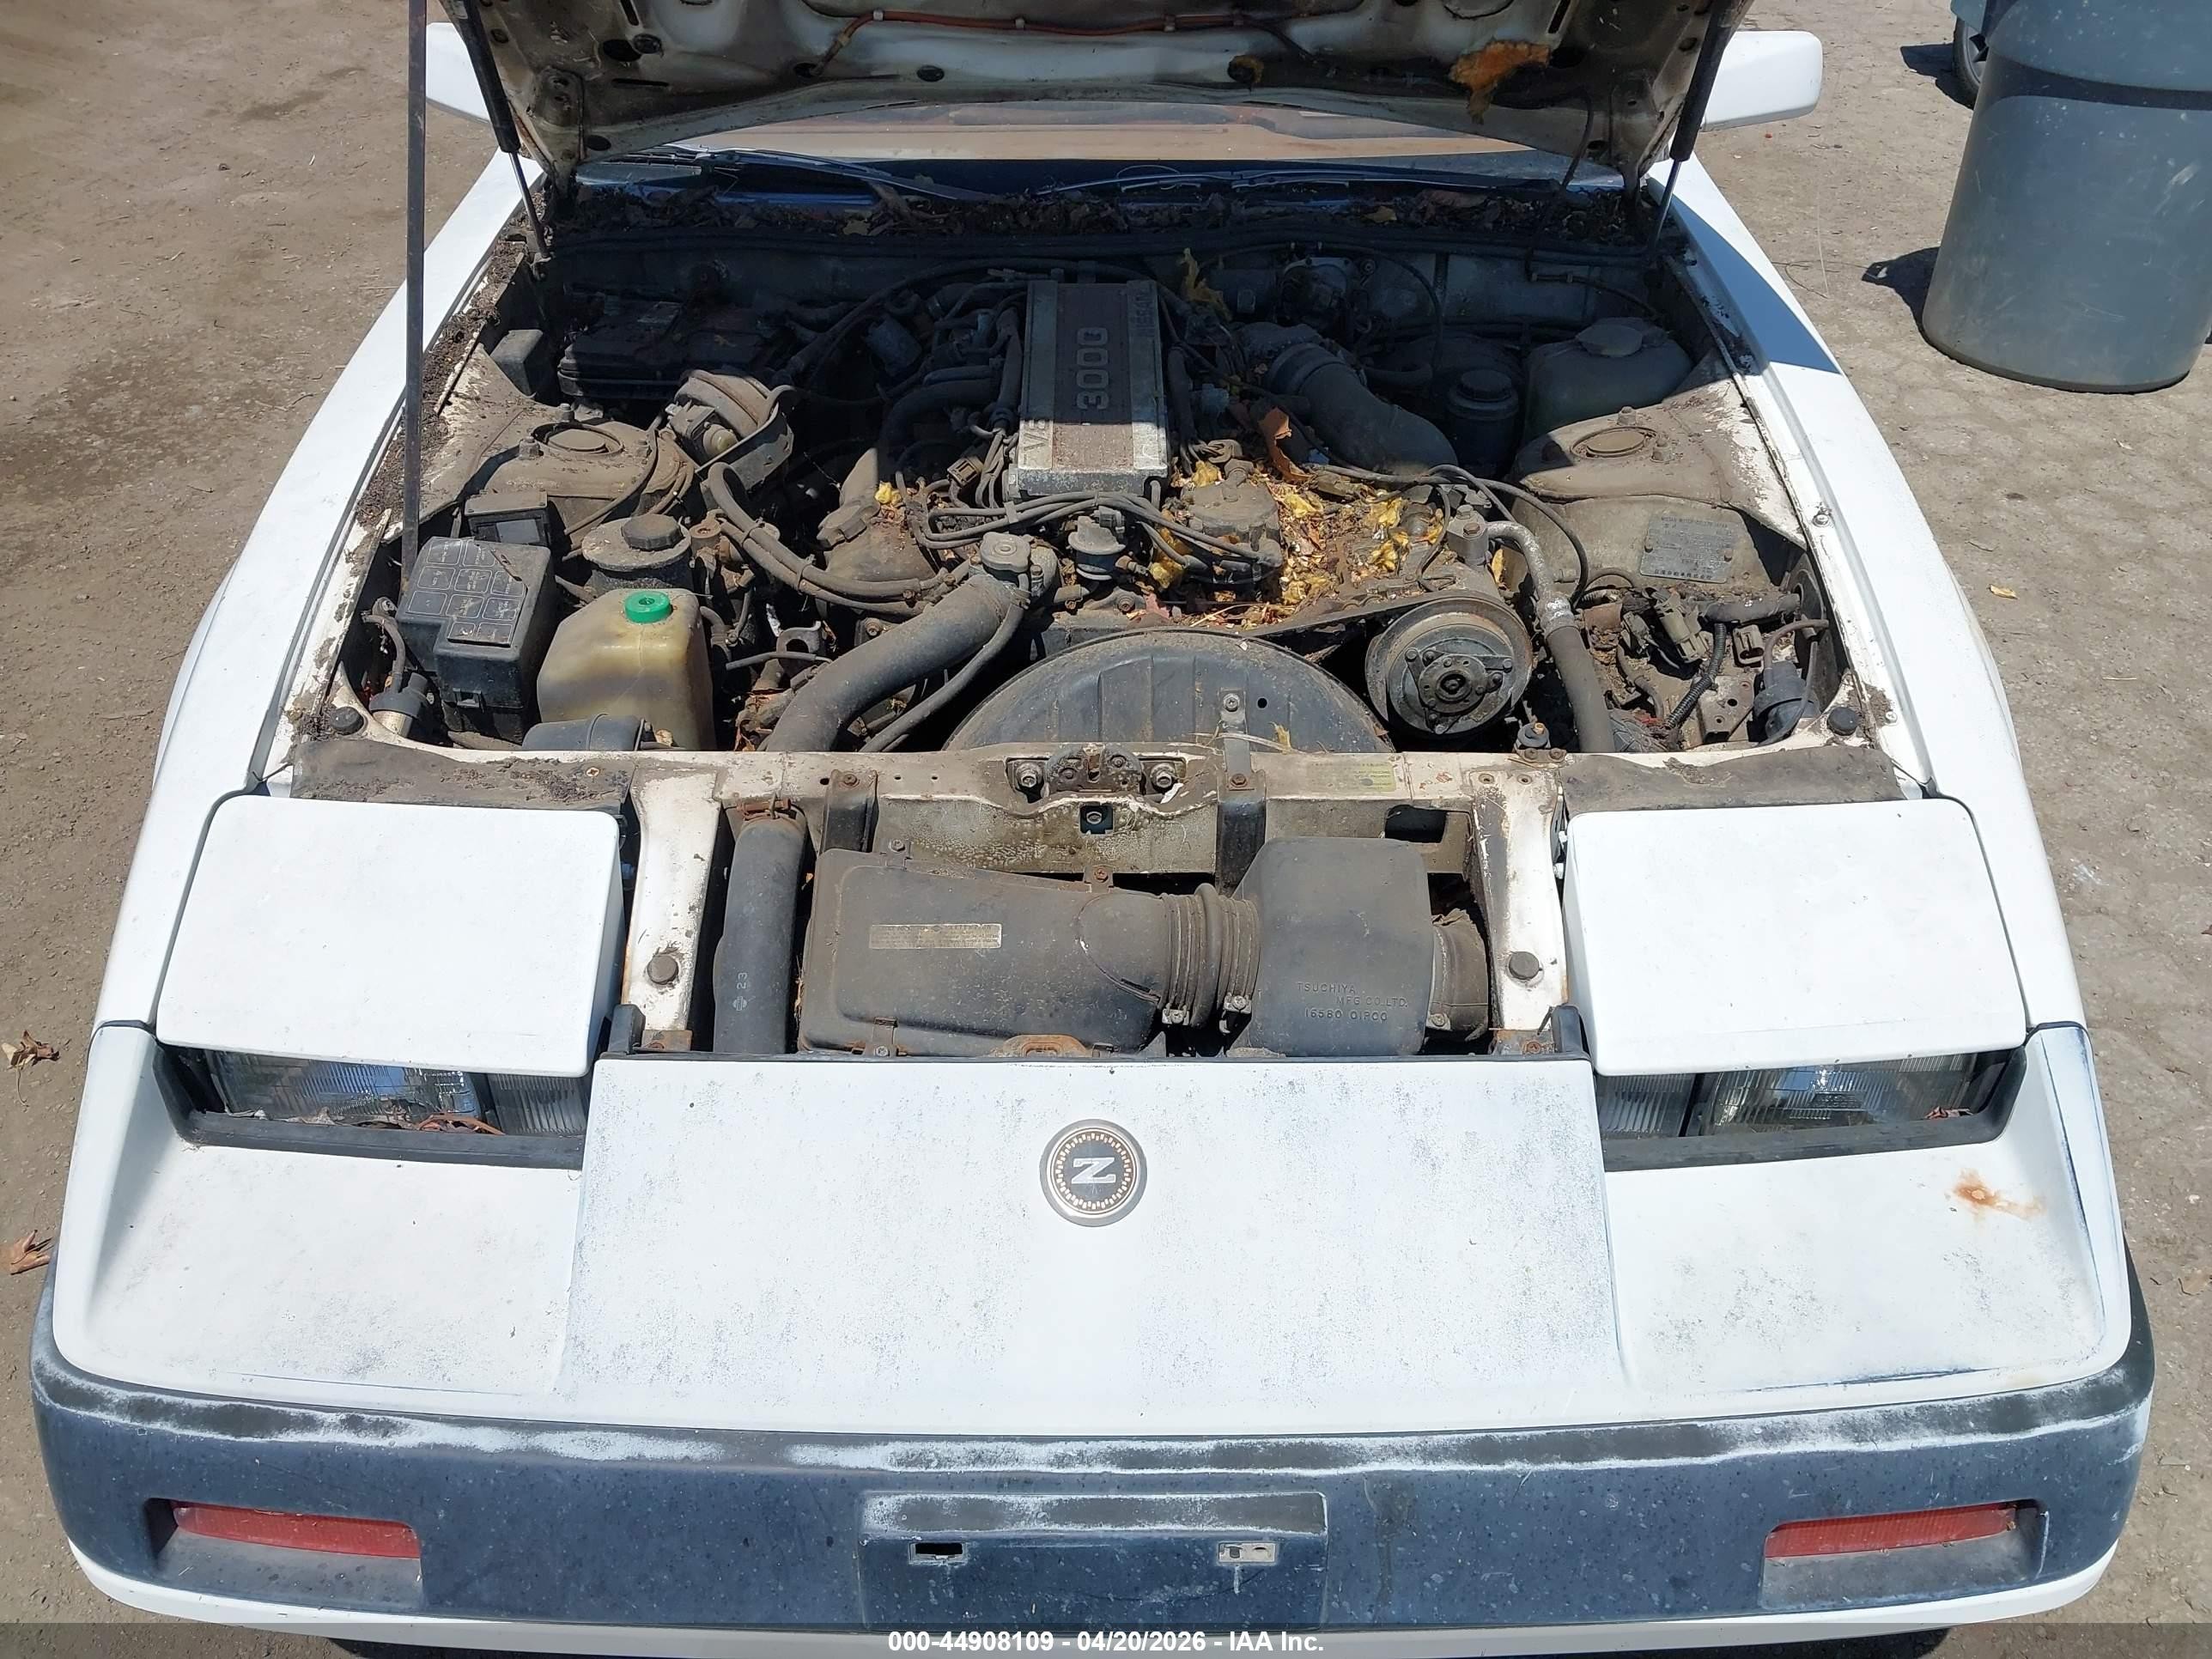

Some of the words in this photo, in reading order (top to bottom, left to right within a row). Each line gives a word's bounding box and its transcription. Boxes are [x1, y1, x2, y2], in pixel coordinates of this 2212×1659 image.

[1076, 327, 1109, 410] 3000
[737, 972, 748, 990] 23
[1297, 982, 1356, 994] TSUCHIYA
[1336, 996, 1360, 1006] MFG
[1305, 1009, 1342, 1019] 16580
[1072, 1157, 1116, 1184] Z
